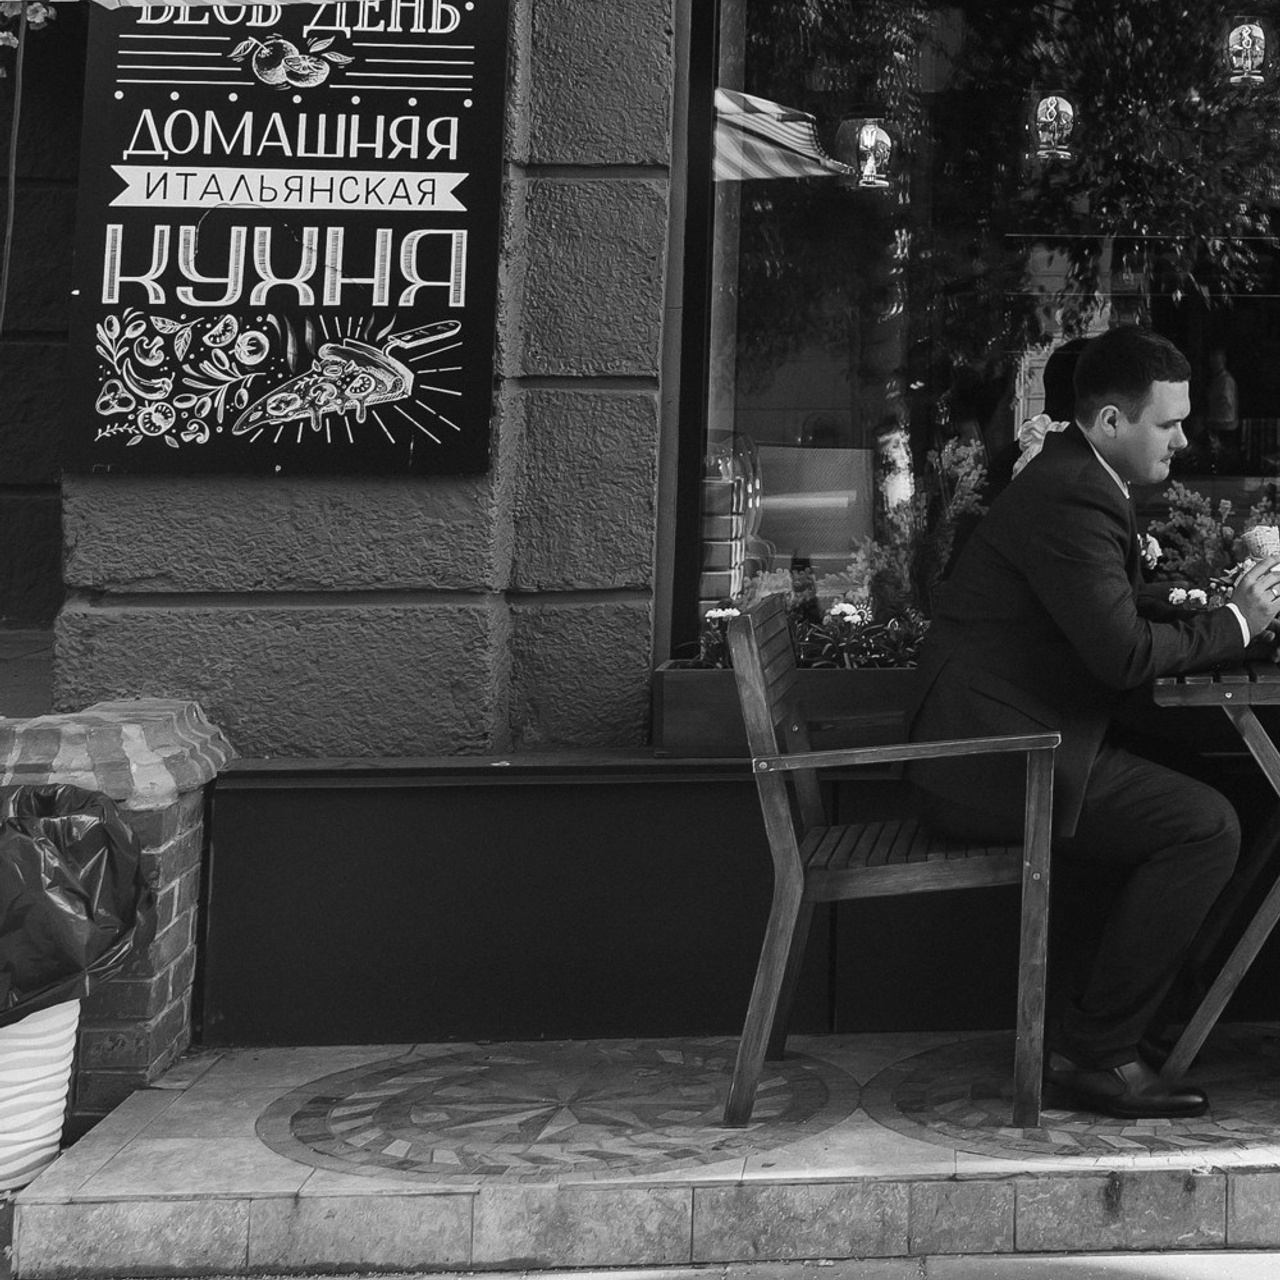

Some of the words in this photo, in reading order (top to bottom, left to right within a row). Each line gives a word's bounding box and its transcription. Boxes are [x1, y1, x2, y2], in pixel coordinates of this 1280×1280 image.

[123, 109, 459, 160] ДОМАШНЯЯ
[144, 172, 437, 205] ИТАЛЬЯНСКАЯ
[102, 224, 468, 307] КУХНЯ
